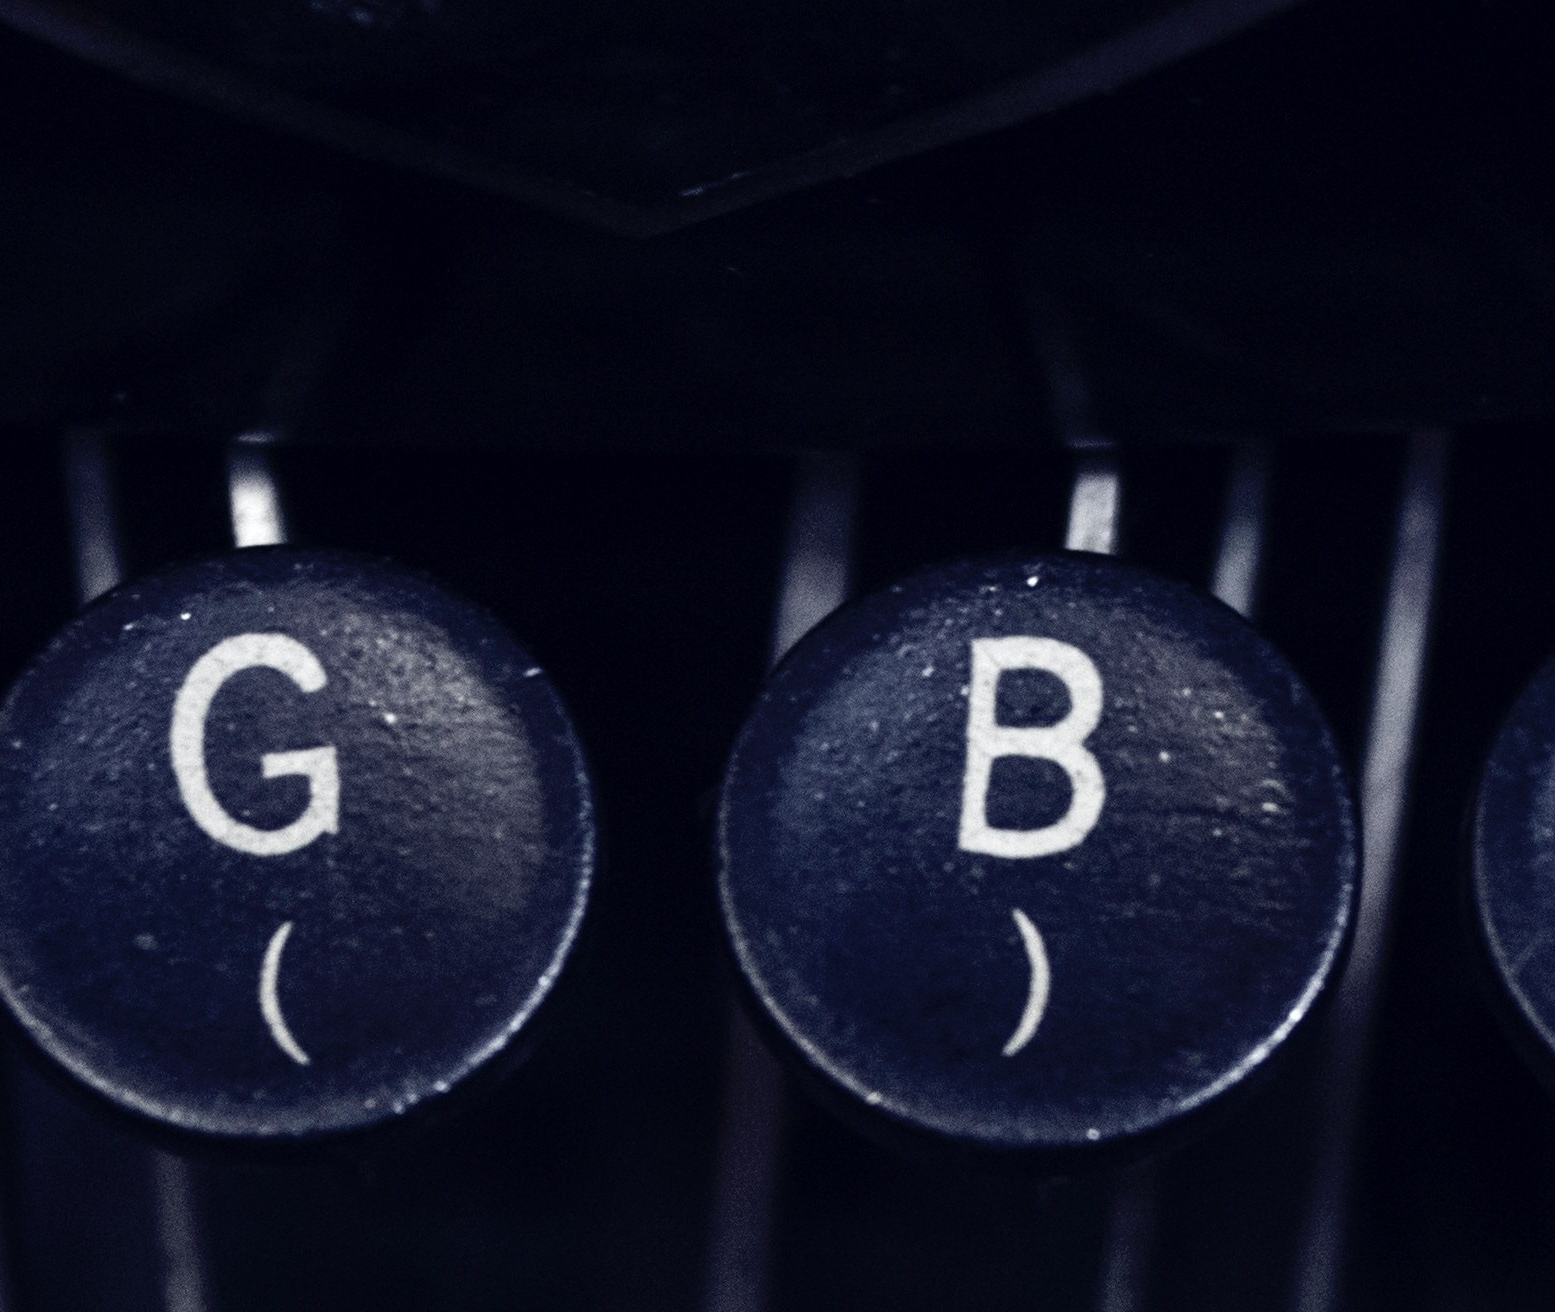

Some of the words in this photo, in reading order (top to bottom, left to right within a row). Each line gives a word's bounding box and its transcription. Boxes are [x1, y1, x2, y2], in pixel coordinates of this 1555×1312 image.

[169, 632, 340, 856] G
[958, 634, 1105, 858] B
[259, 921, 311, 1066] (
[1002, 908, 1051, 1057] )
